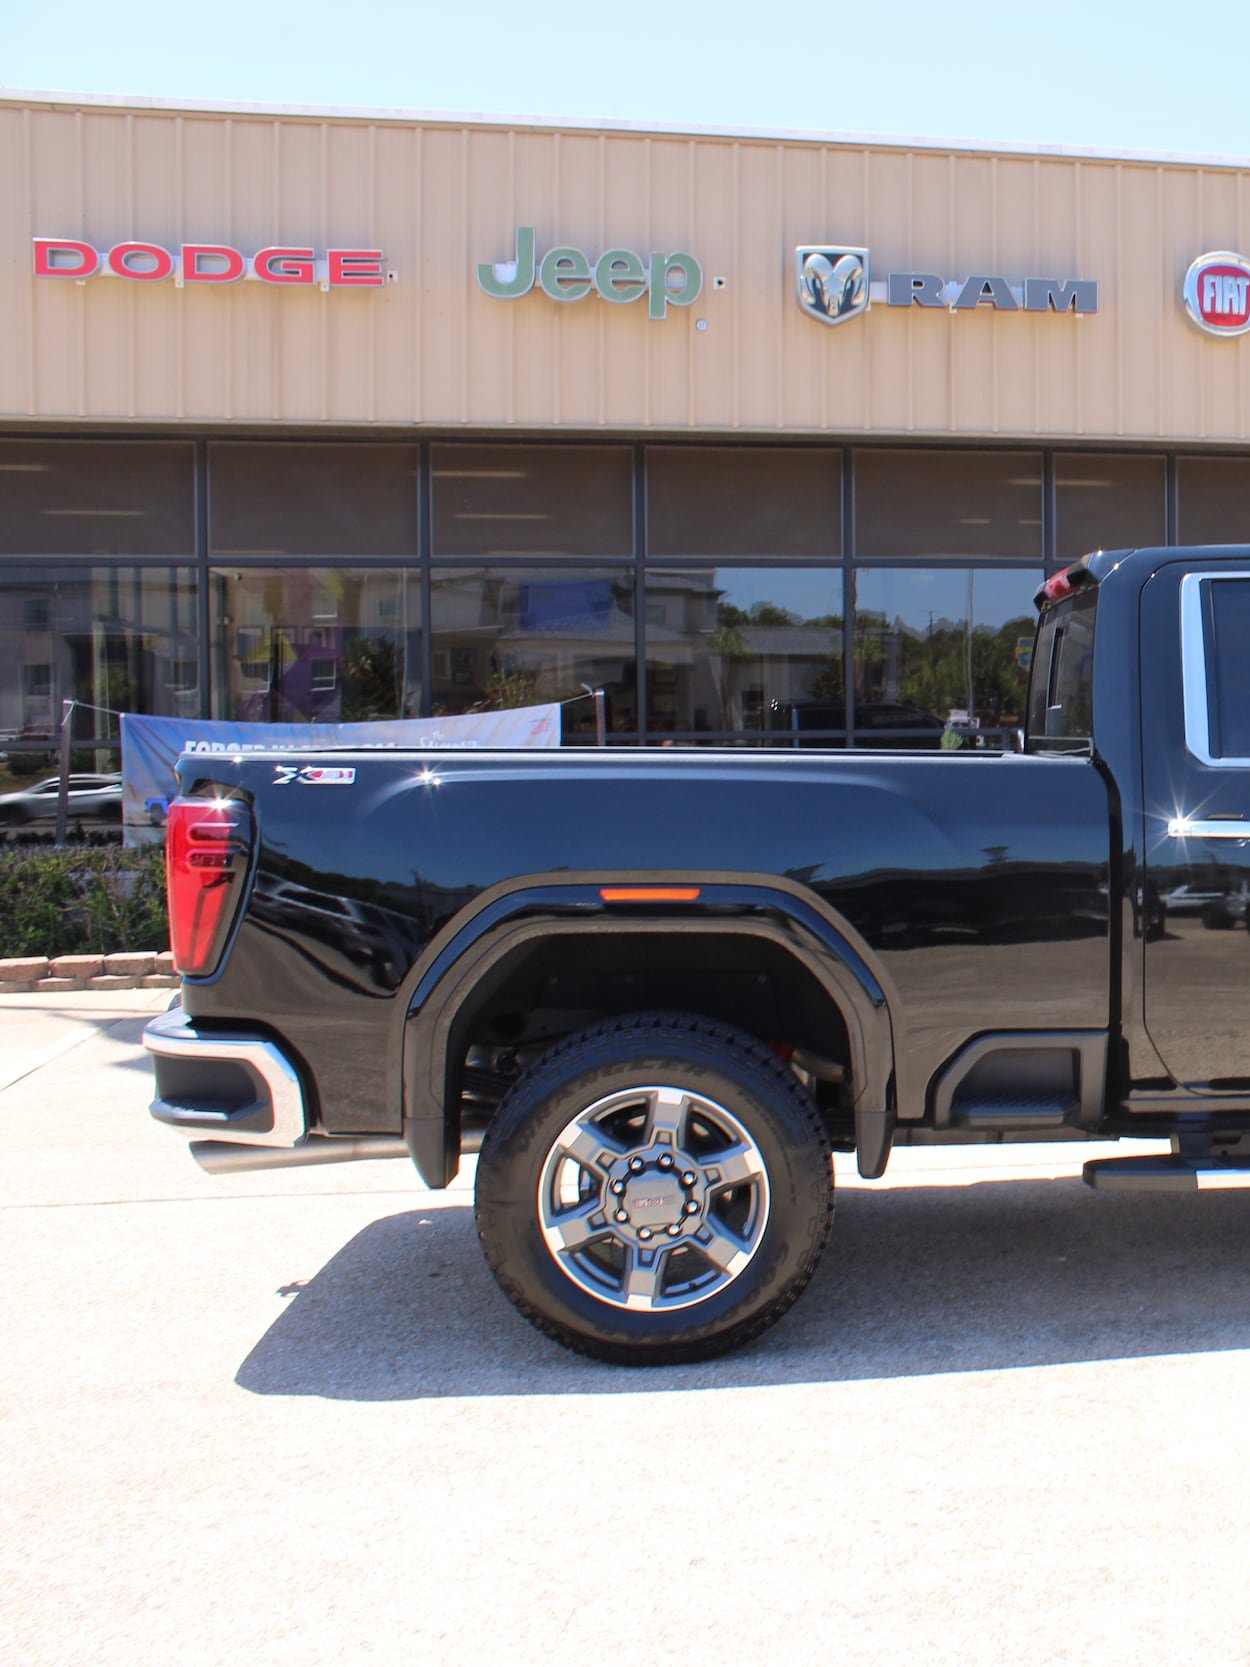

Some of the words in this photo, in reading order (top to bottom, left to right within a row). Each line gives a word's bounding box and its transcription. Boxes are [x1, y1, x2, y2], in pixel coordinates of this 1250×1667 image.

[32, 236, 384, 286] DODGE
[476, 225, 703, 320] Jeep
[888, 272, 1099, 313] RAM
[1203, 274, 1250, 315] FIAT
